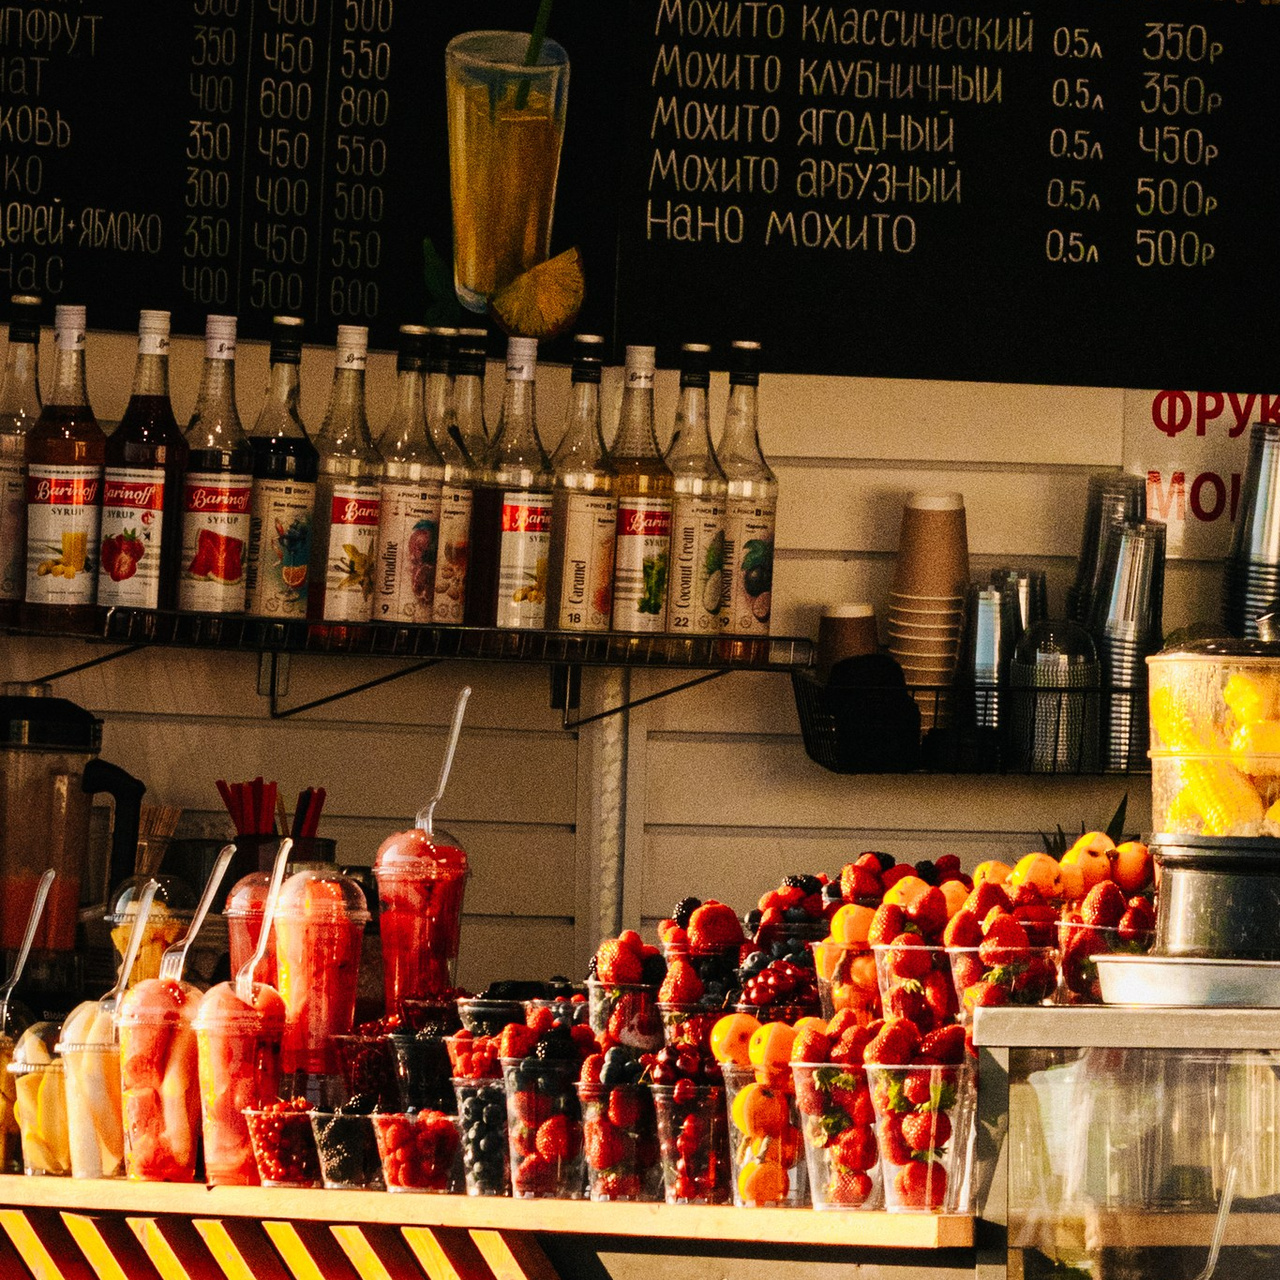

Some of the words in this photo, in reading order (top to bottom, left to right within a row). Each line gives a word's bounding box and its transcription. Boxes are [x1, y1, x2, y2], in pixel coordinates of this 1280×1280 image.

[191, 24, 236, 66] 350
[263, 31, 315, 74] 450
[340, 38, 391, 81] 550
[802, 5, 1034, 53] классический
[1053, 25, 1103, 60] 0.5л
[1142, 22, 1224, 64] 350р
[189, 72, 234, 114] 400
[259, 77, 312, 121] 600
[338, 84, 390, 128] 800
[651, 43, 782, 93] Мохито
[1052, 77, 1104, 111] 0.5л
[1141, 71, 1222, 115] 350р
[186, 119, 232, 161] 350
[258, 126, 311, 169] 450
[335, 134, 387, 177] 550
[650, 95, 780, 144] Мохито
[797, 107, 955, 155] ягодный
[1050, 126, 1104, 160] 0.5л
[1139, 124, 1219, 166] 450р
[185, 166, 230, 209] 300
[255, 174, 309, 216] 400
[334, 182, 384, 222] 500
[648, 148, 779, 194] Мохито
[796, 157, 962, 204] арбузный
[1047, 178, 1101, 212] 0.5л
[1136, 177, 1218, 217] 500р
[184, 215, 230, 258] 350
[254, 221, 308, 264] 450
[331, 227, 382, 269] 550
[646, 198, 745, 244] Нано
[765, 210, 917, 254] мохито
[1046, 228, 1099, 263] 0.5л
[1136, 229, 1216, 267] 500р
[182, 265, 229, 305] 400
[250, 268, 303, 310] 500
[330, 275, 380, 318] 600
[35, 480, 98, 502] Barinoff
[51, 508, 85, 517] SYRUP
[207, 516, 240, 525] SYRUP
[678, 526, 695, 563] Cream
[380, 540, 398, 595] Grenadine
[569, 560, 587, 604] Caramel
[676, 565, 693, 608] Coconut
[382, 604, 390, 614] 9
[567, 613, 581, 623] 18
[674, 617, 689, 627] 22
